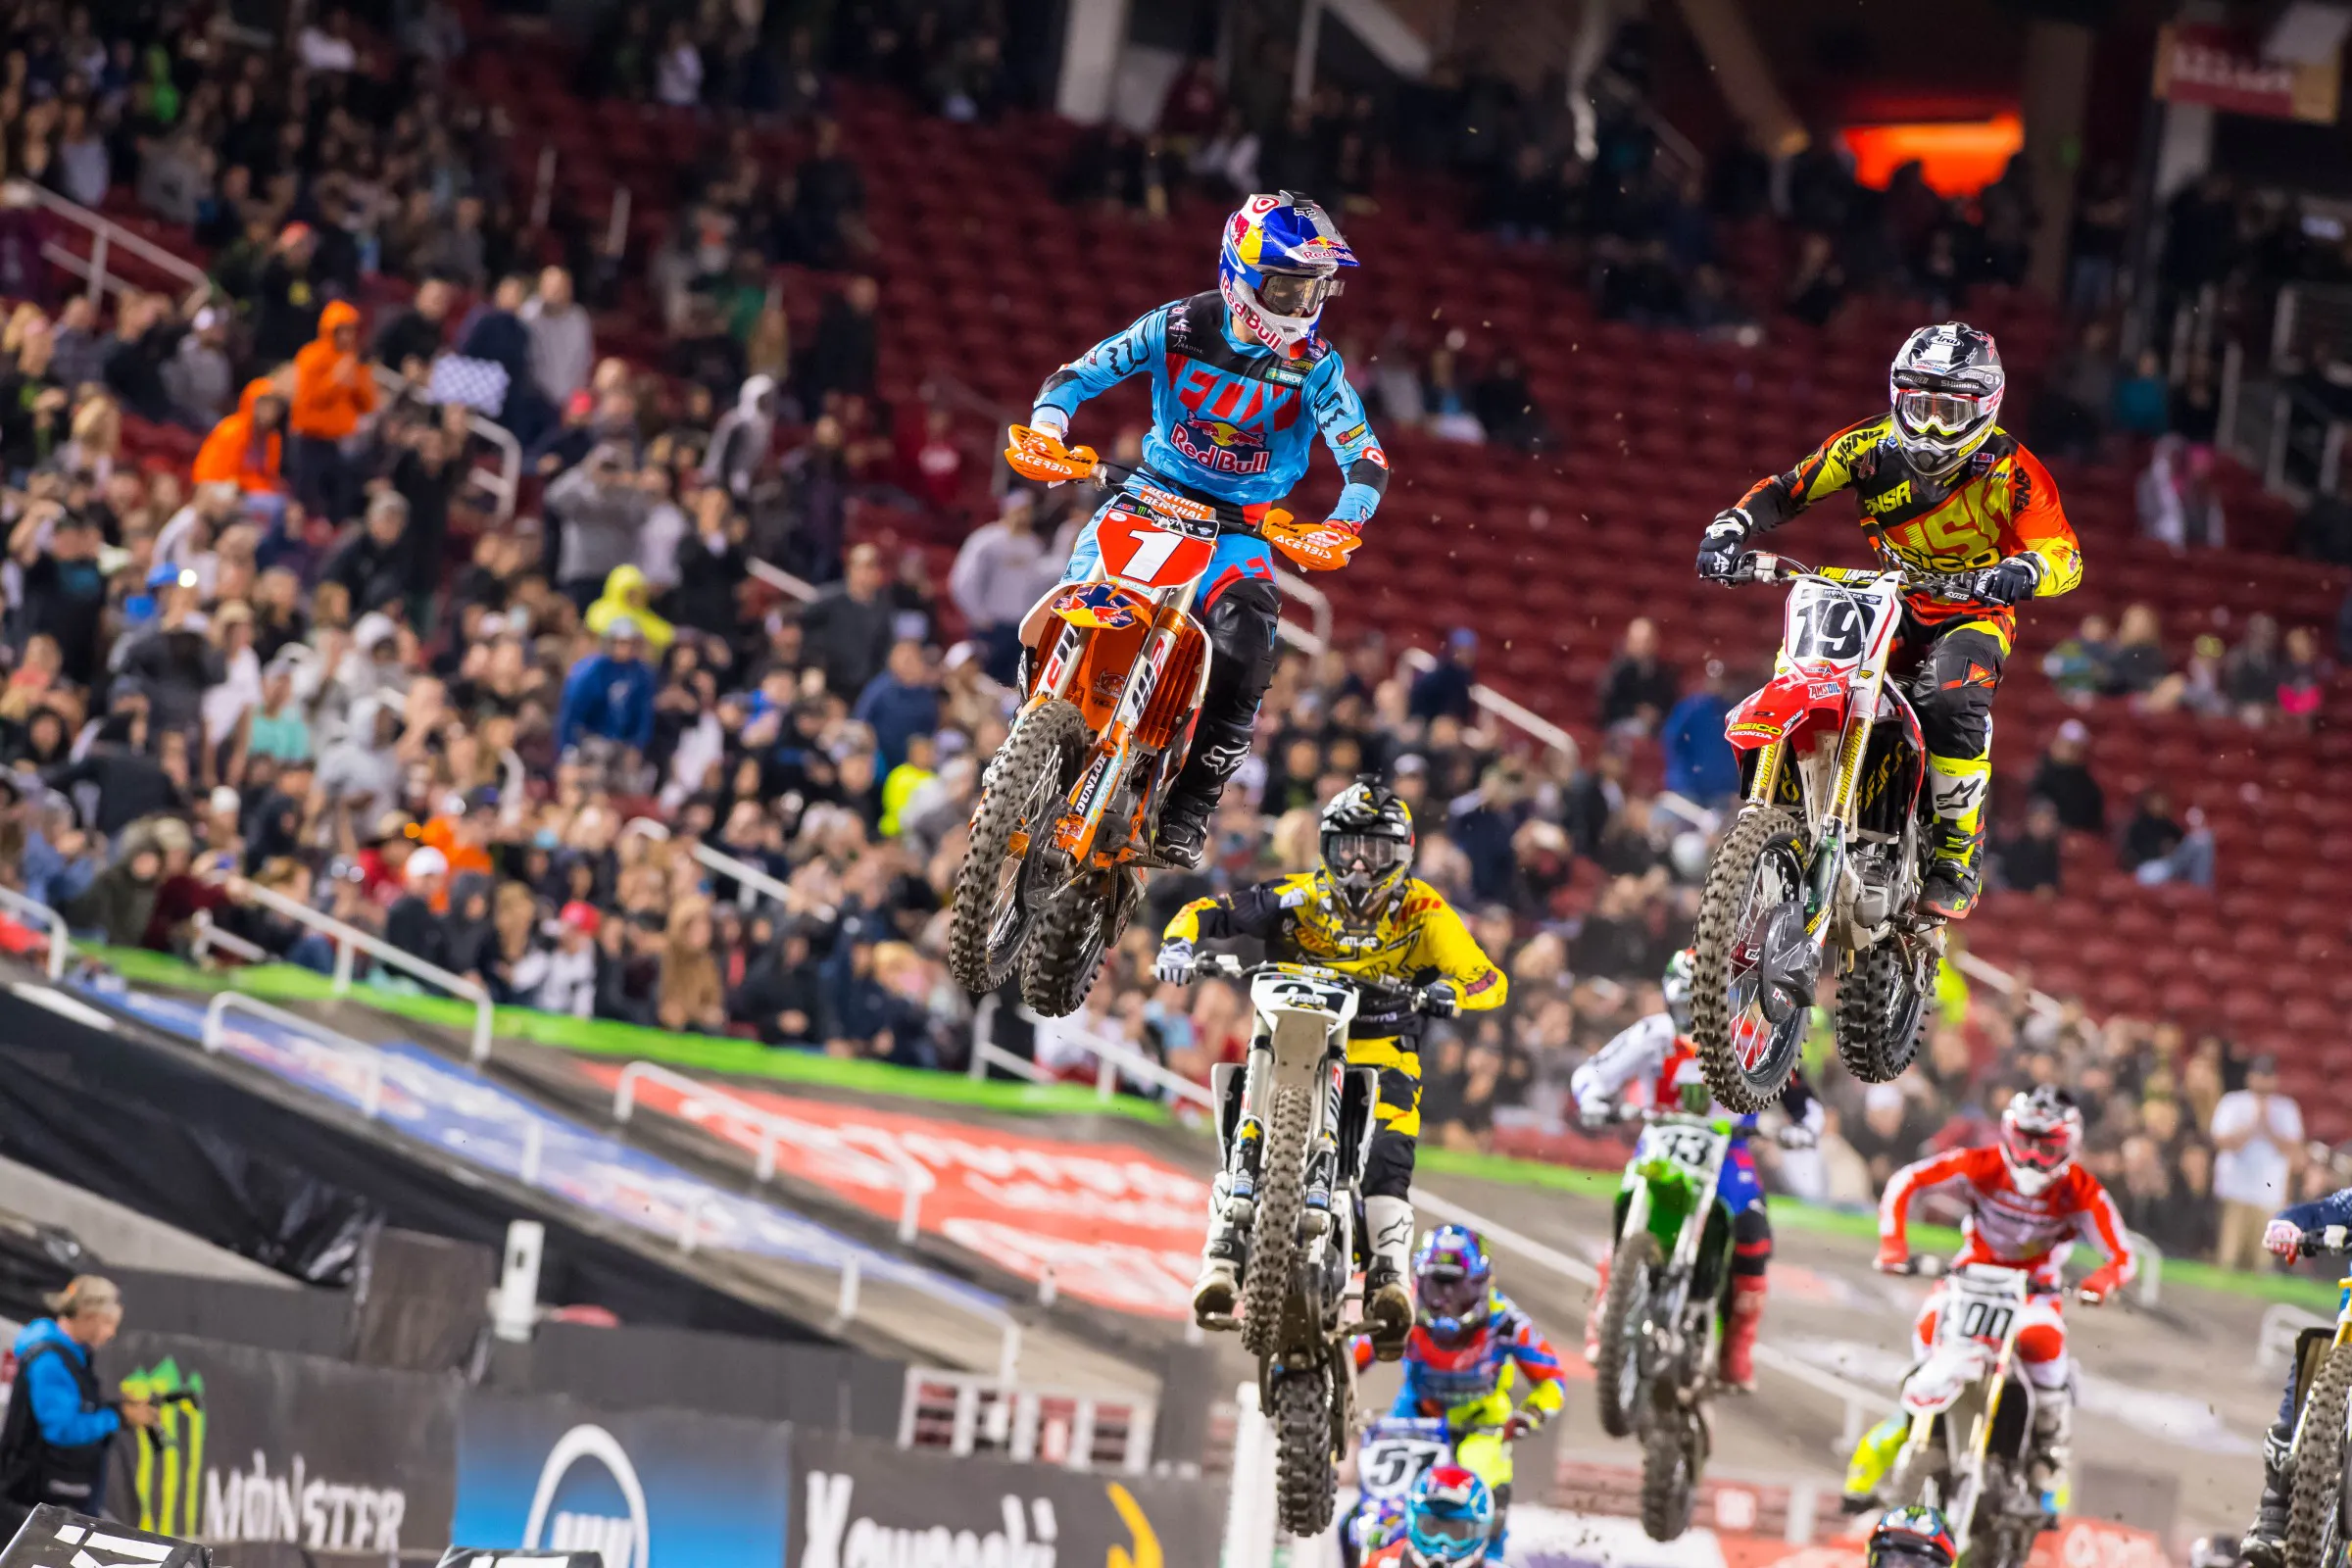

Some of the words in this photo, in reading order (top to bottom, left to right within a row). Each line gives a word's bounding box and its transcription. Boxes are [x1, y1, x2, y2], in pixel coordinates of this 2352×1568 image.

[1940, 379, 1980, 389] SHIMANO
[1120, 528, 1185, 584] 1
[1793, 599, 1877, 660] 19
[1809, 683, 1841, 699] AMSOIL
[1729, 722, 1783, 735] GEICO
[1730, 730, 1773, 740] HONDA
[1339, 935, 1378, 948] ATLAS
